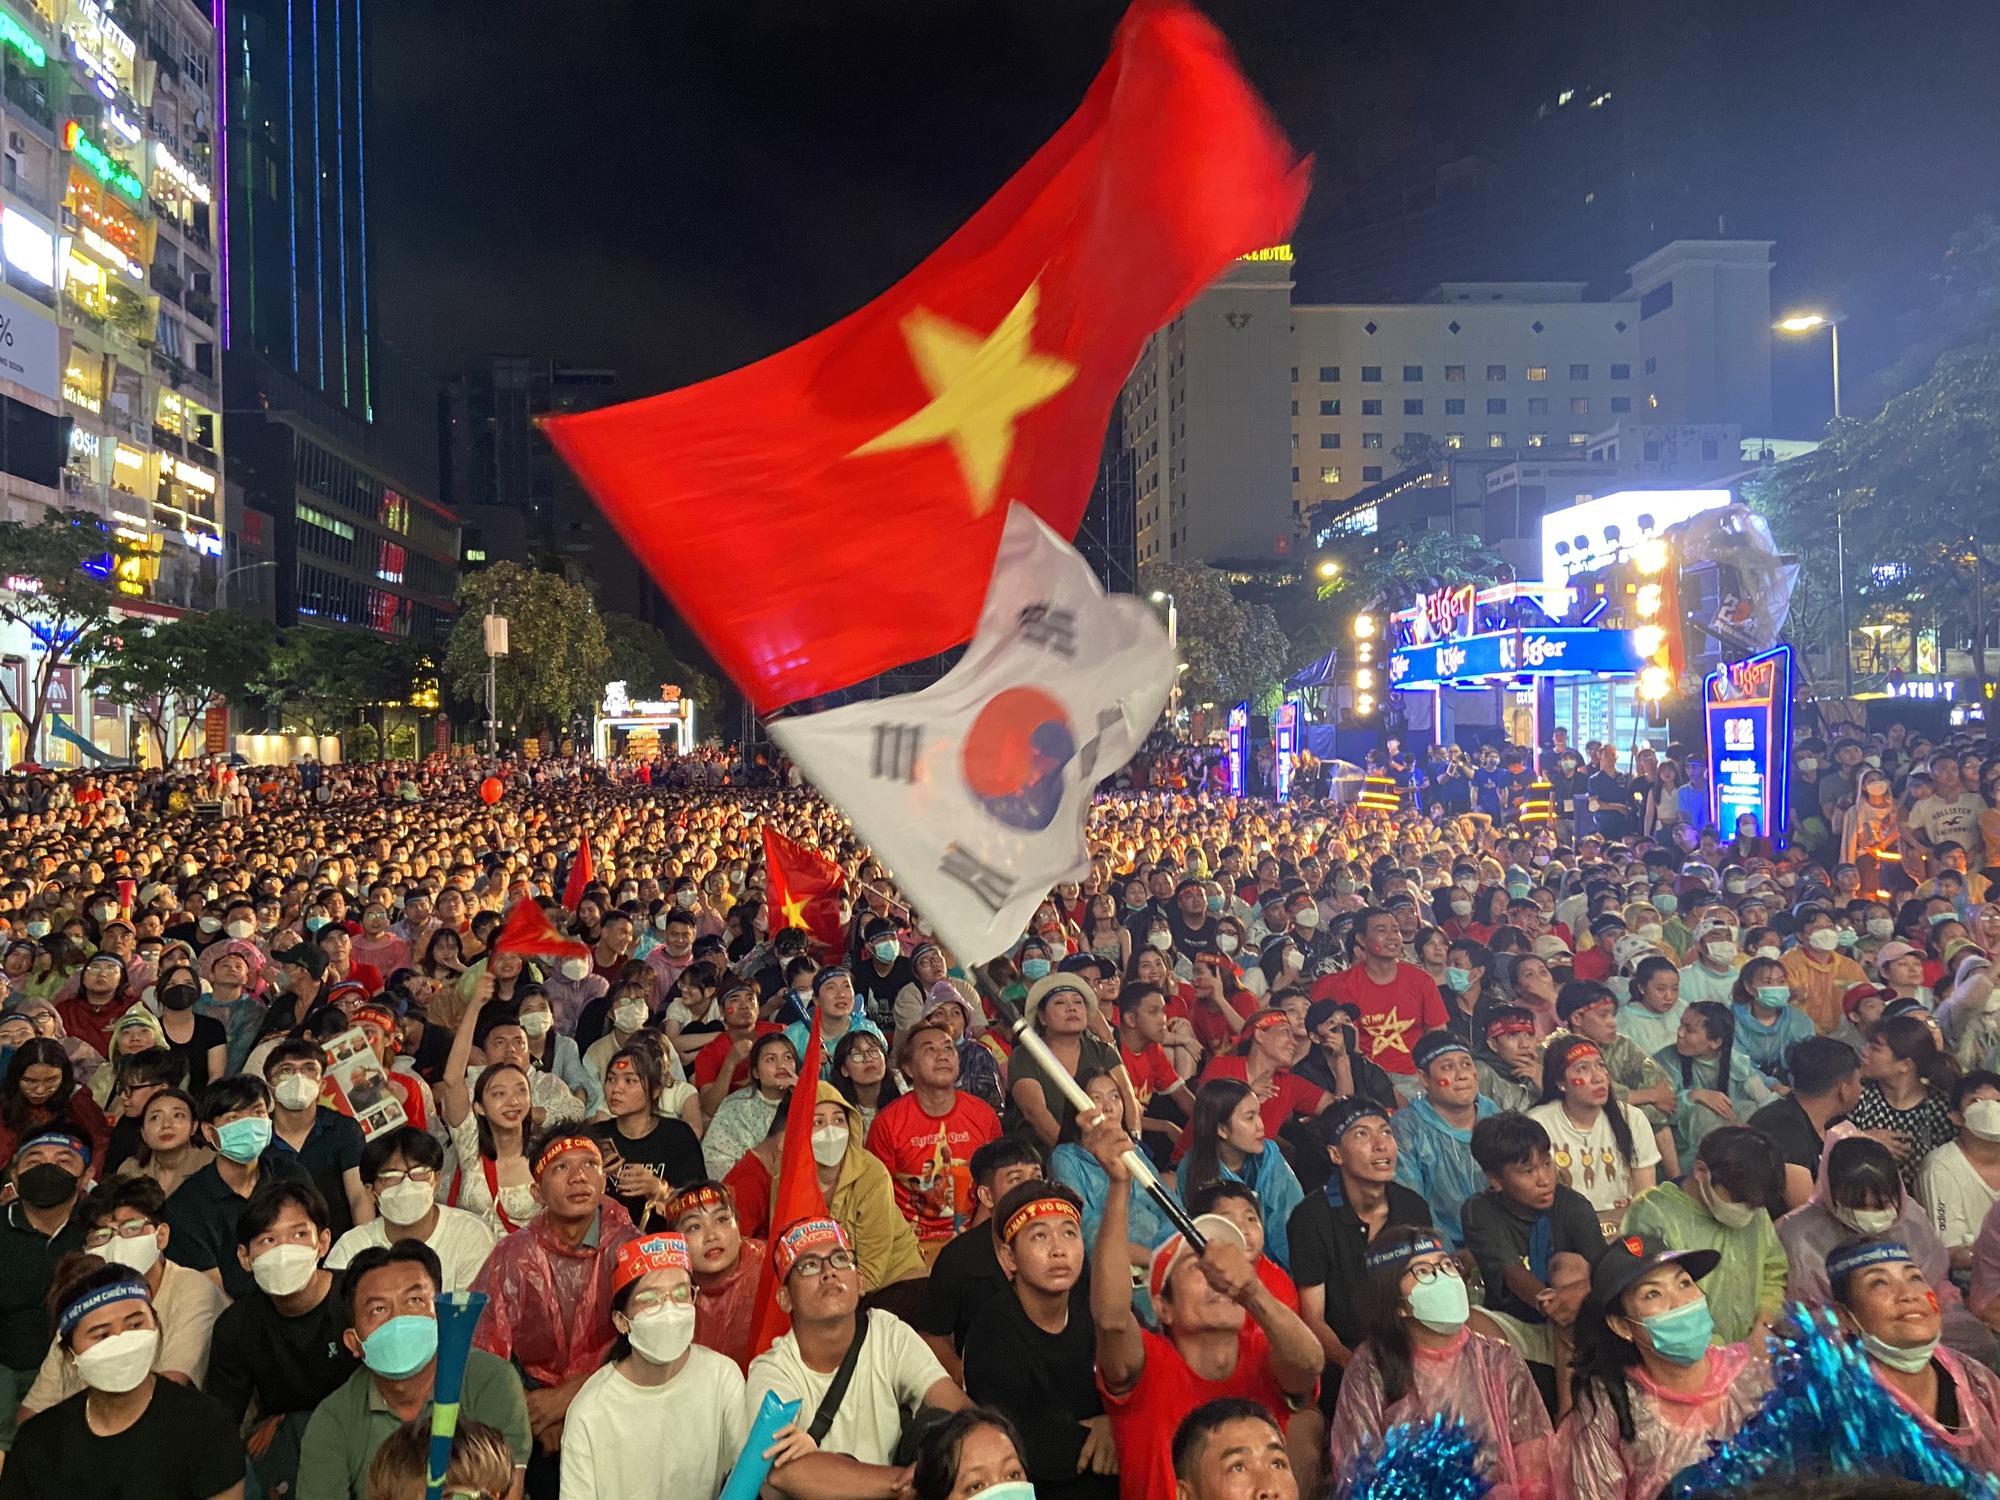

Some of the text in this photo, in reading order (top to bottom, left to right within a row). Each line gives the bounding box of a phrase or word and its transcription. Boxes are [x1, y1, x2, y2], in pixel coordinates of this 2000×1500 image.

[1260, 244, 1294, 261] HOTEL
[1427, 586, 1466, 635] Tiger
[1730, 660, 1767, 696] Tiger
[547, 1143, 563, 1161] NAM
[1011, 1212, 1028, 1232] NAM
[641, 1236, 669, 1256] VIỆT
[82, 1294, 101, 1310] NAM
